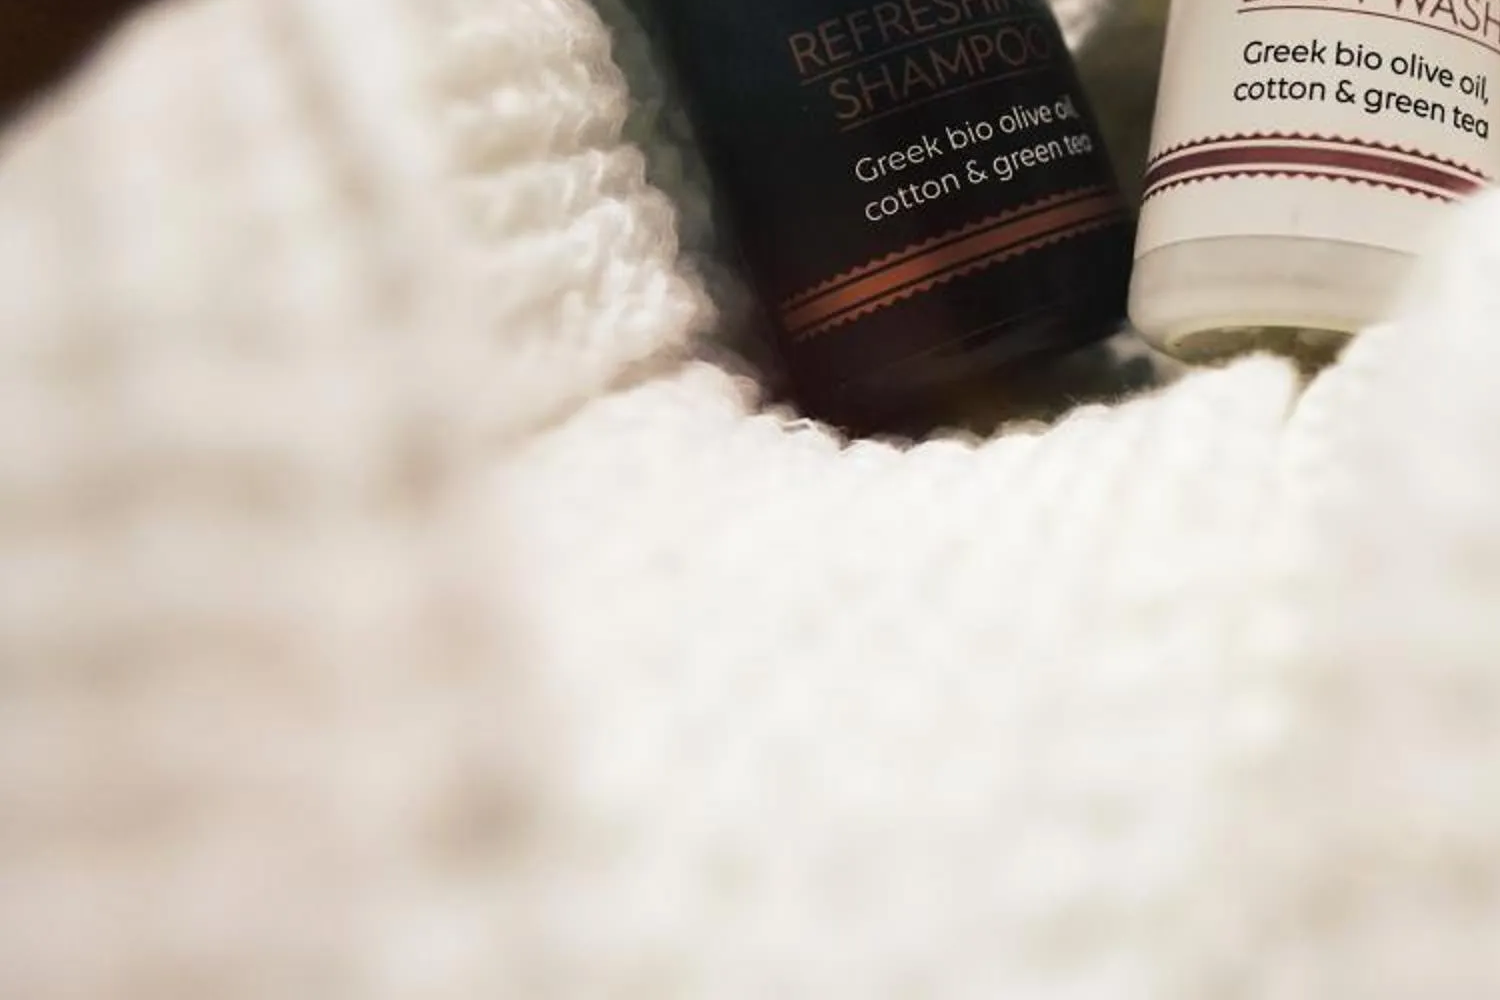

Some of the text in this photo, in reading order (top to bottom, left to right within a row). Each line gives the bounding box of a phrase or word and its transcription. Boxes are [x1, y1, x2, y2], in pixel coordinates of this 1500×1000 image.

[1233, 77, 1490, 139] cotton & green tea
[1243, 40, 1490, 105] Greek bio olive oil,
[855, 135, 942, 183] Greek
[946, 120, 993, 151] bio
[999, 104, 1053, 134] olive
[865, 170, 961, 222] cotton
[966, 159, 988, 186] &
[993, 140, 1063, 182] green
